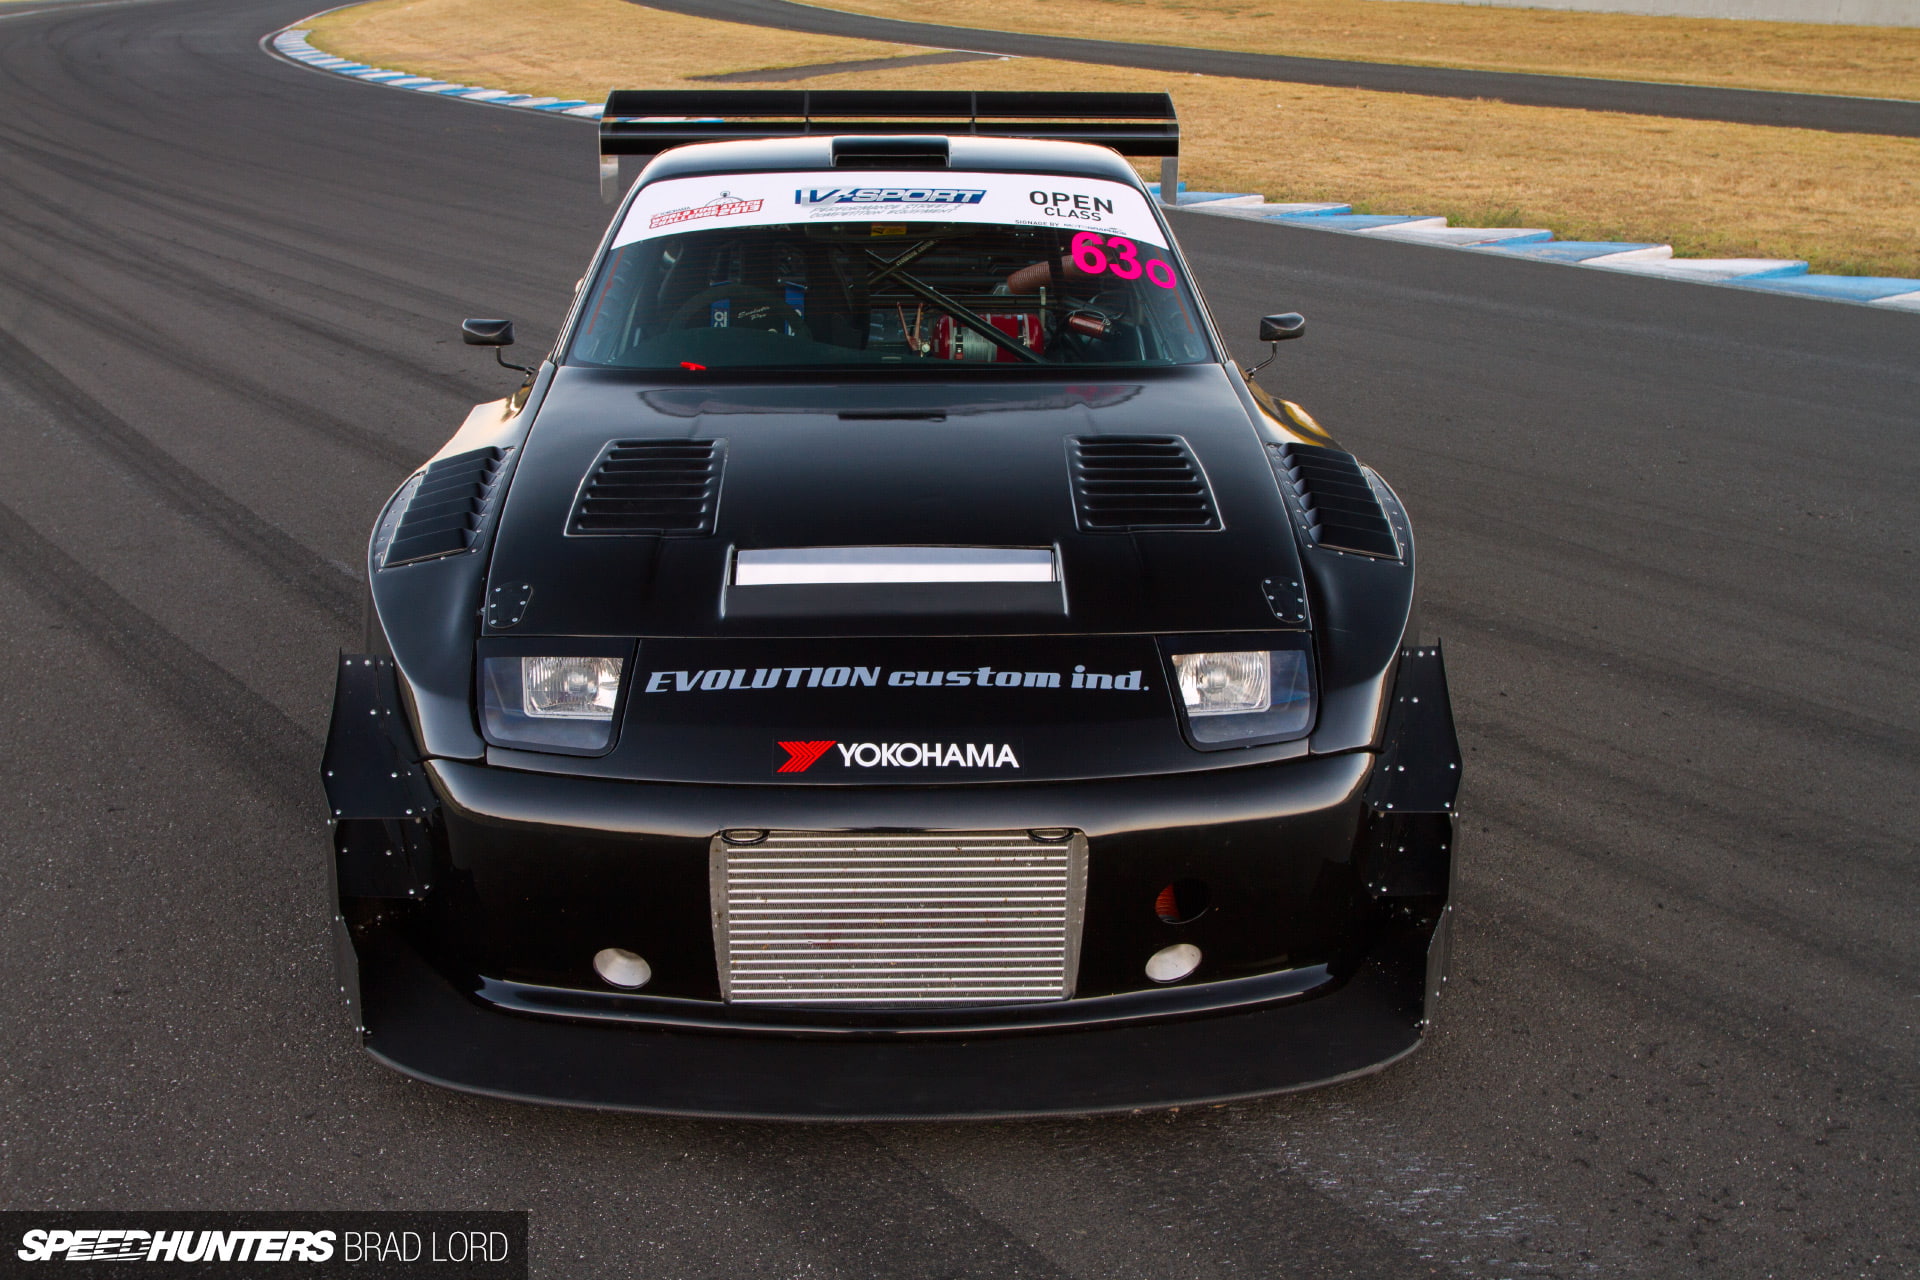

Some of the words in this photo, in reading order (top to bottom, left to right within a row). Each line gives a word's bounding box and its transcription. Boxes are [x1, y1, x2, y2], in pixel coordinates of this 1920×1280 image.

[651, 210, 691, 224] WORLD
[694, 206, 719, 214] TIME
[720, 201, 761, 209] ATTACK
[1029, 190, 1113, 214] OPEN
[1044, 207, 1102, 221] CLASS
[650, 212, 718, 228] CHALLENGE
[719, 205, 761, 216] 2013
[1071, 231, 1143, 280] 63
[644, 666, 881, 693] EVOLUTION
[888, 667, 1060, 687] custom
[1071, 665, 1149, 690] ind.
[837, 743, 1019, 768] YOKOHAMA
